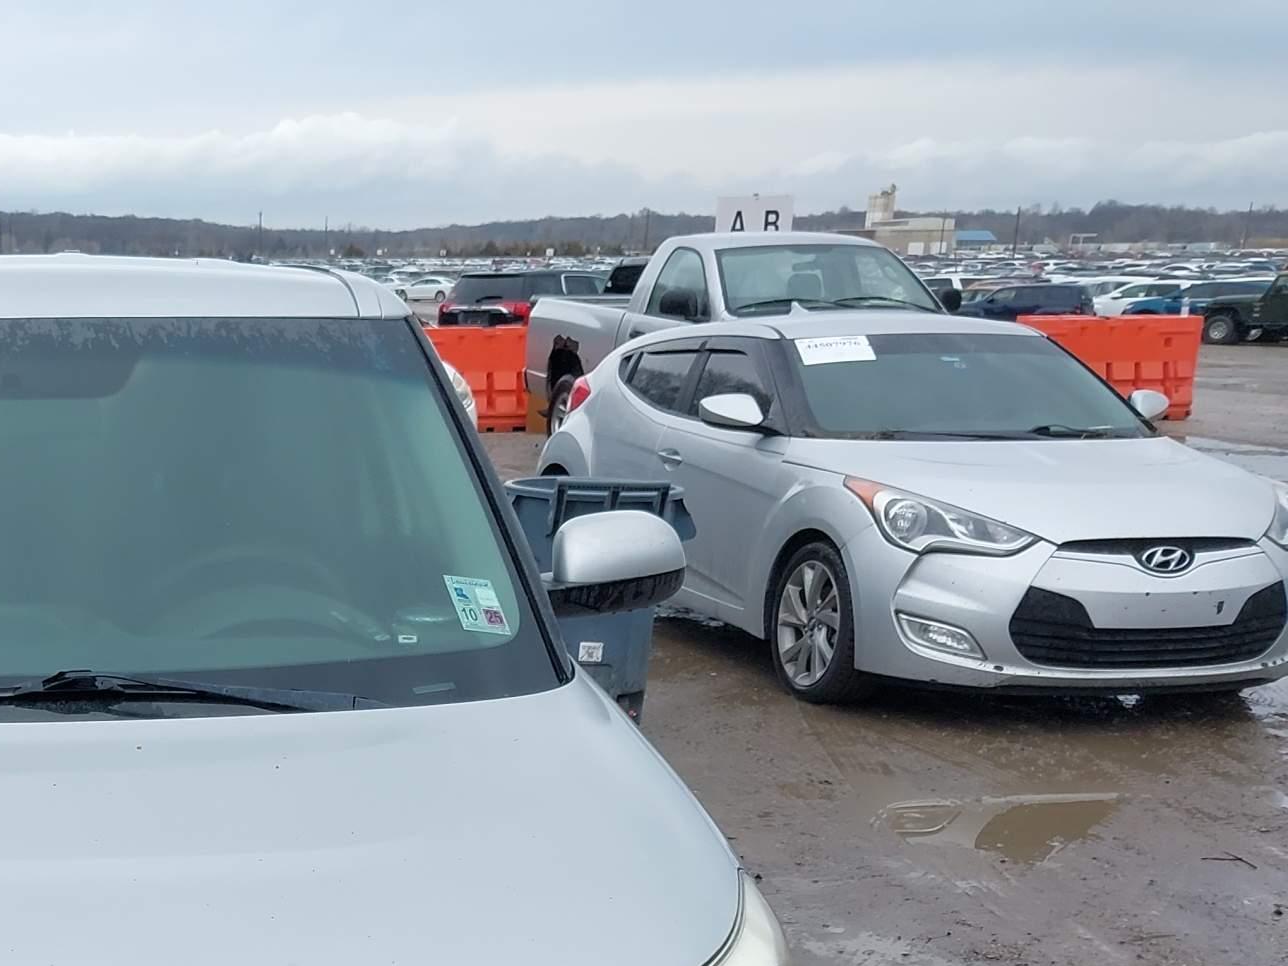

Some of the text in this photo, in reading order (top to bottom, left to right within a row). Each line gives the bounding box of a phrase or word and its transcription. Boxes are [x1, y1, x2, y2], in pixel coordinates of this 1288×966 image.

[730, 210, 745, 232] A
[461, 607, 504, 624] 10 25
